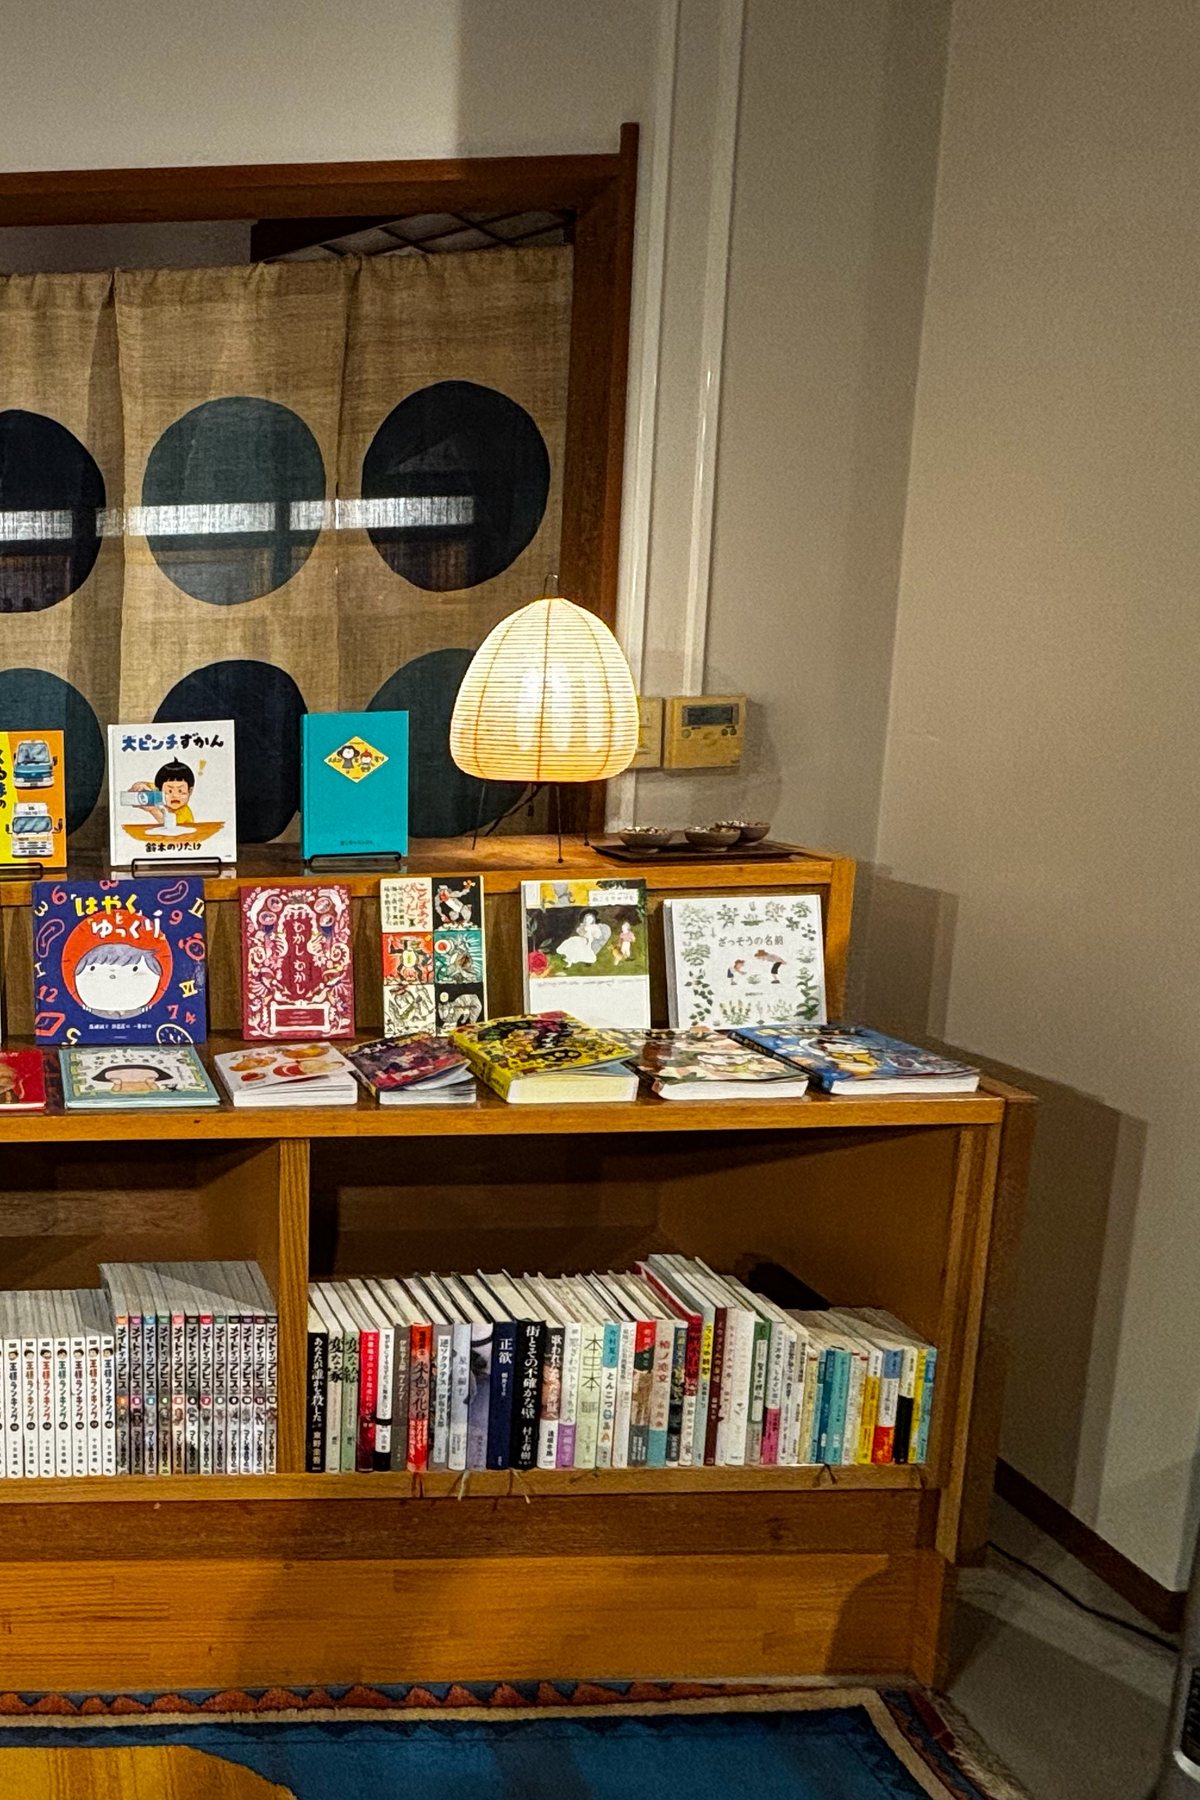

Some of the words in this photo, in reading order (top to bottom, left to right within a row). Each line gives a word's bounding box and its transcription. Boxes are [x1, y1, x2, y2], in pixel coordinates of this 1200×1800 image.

[121, 732, 224, 752] 大ピンチずかん
[52, 886, 67, 905] 6
[169, 910, 183, 925] 9
[718, 934, 784, 947] ざっそうの名前
[37, 985, 58, 1003] 12
[117, 1326, 128, 1389] メイドインアビス
[132, 1326, 141, 1389] メイドインアビス
[145, 1326, 155, 1389] メイドインアビス
[160, 1326, 169, 1389] メイドインアビス
[174, 1326, 183, 1389] メイドインアビス
[188, 1326, 197, 1389] メイドインアビス
[202, 1326, 211, 1389] メイドインアビス
[216, 1326, 225, 1389] メイドインアビス
[230, 1326, 239, 1389] メイドインアビス
[242, 1326, 252, 1389] メイドインアビス
[256, 1326, 265, 1389] メイドインアビス
[268, 1326, 277, 1389] メイドインアビス
[311, 1337, 325, 1422] あなたが誰かを殺した
[328, 1336, 344, 1382] 変な家
[342, 1337, 359, 1382] 変な絵
[438, 1339, 449, 1385] 逆ソクラテス
[498, 1338, 513, 1364] 正欲
[520, 1325, 540, 1419] 街とその不確かな壁
[9, 1363, 18, 1422] 王様ランキング
[25, 1361, 34, 1420] 王様ランキング
[42, 1361, 51, 1420] 王様ランキング
[58, 1361, 66, 1420] 王様ランキング
[74, 1360, 83, 1420] 王様ランキング
[89, 1360, 98, 1420] 王様ランキング
[104, 1360, 113, 1420] 王様ランキング
[520, 1426, 532, 1460] 村上春樹
